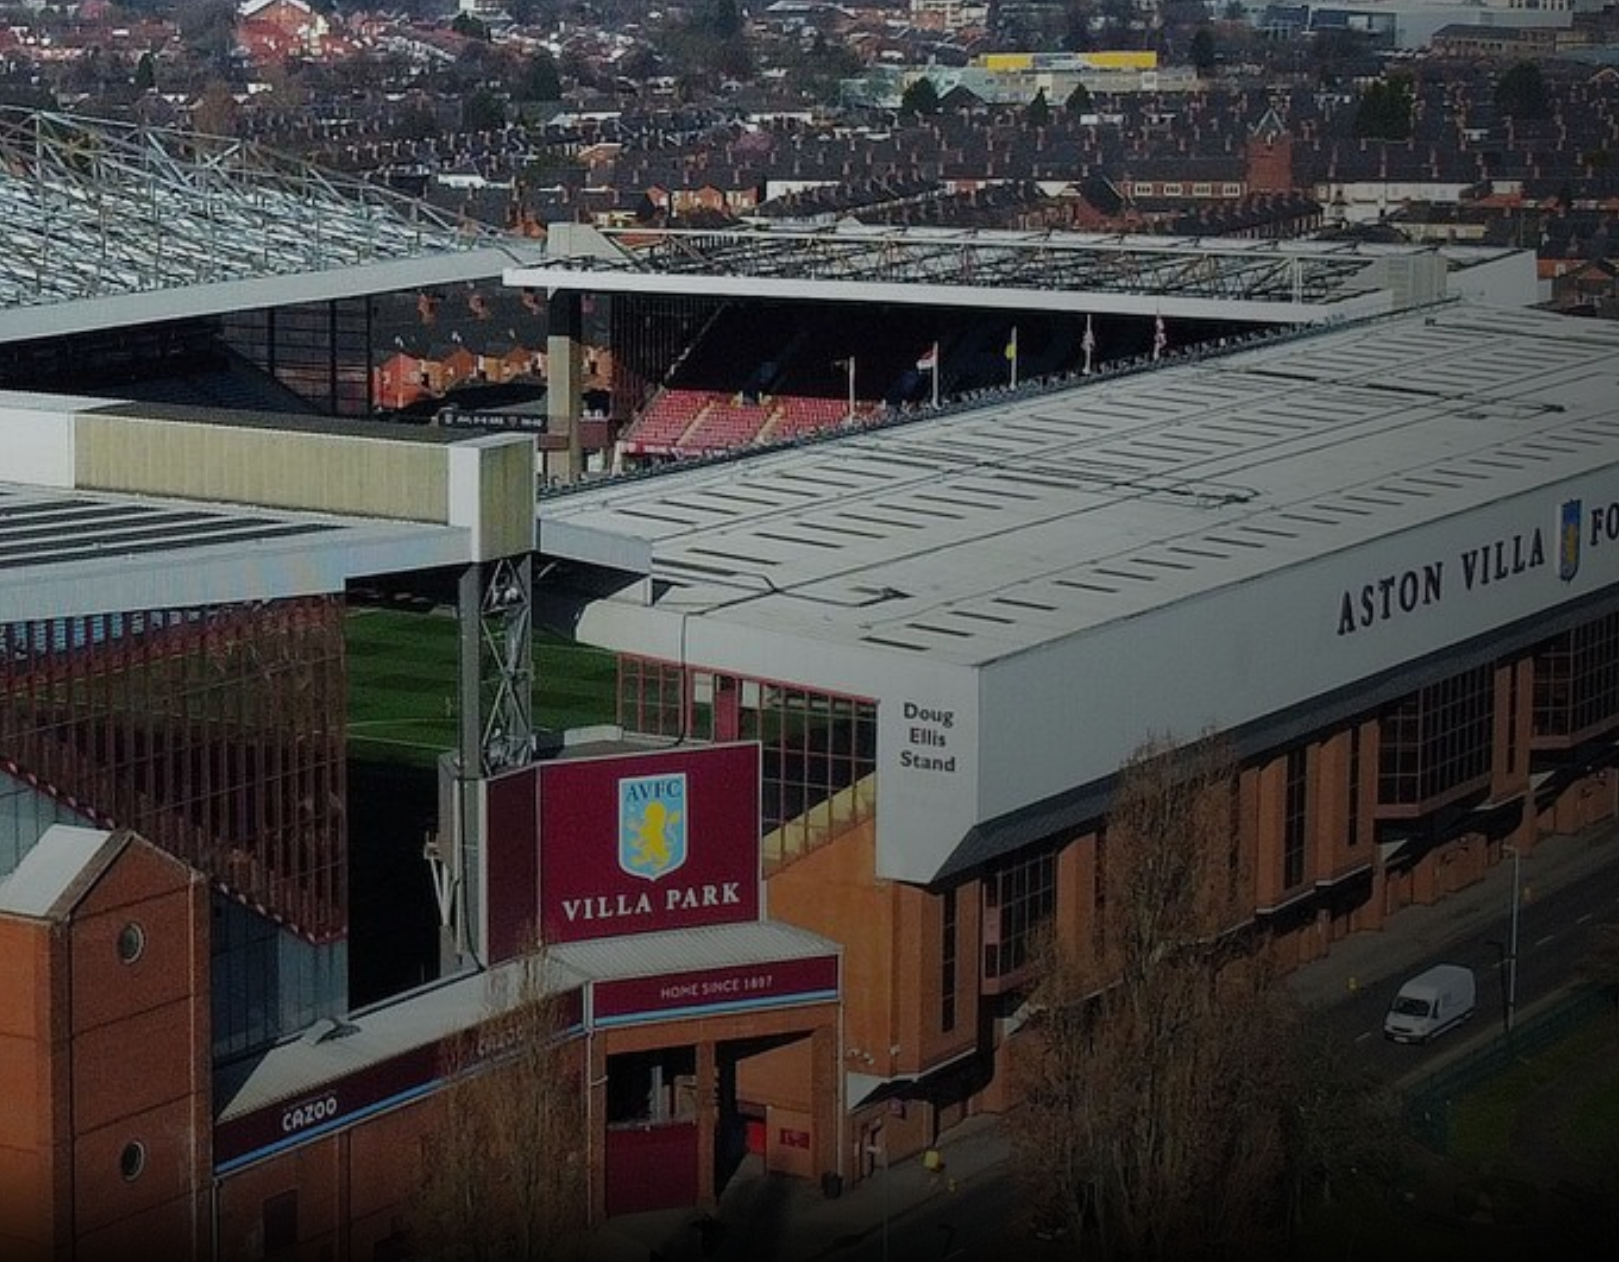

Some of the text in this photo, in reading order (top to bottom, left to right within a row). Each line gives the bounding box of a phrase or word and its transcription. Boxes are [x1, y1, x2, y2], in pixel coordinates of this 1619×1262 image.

[1337, 562, 1443, 636] ASTON
[1461, 528, 1545, 591] VILLA
[903, 701, 954, 729] Doug
[910, 727, 946, 748] Ellis
[900, 750, 956, 773] Stand
[625, 779, 681, 801] AVFC
[562, 881, 740, 922] VILLA PARK
[661, 974, 773, 1000] HOME SINCE 1897
[282, 1096, 338, 1132] CAZOO
